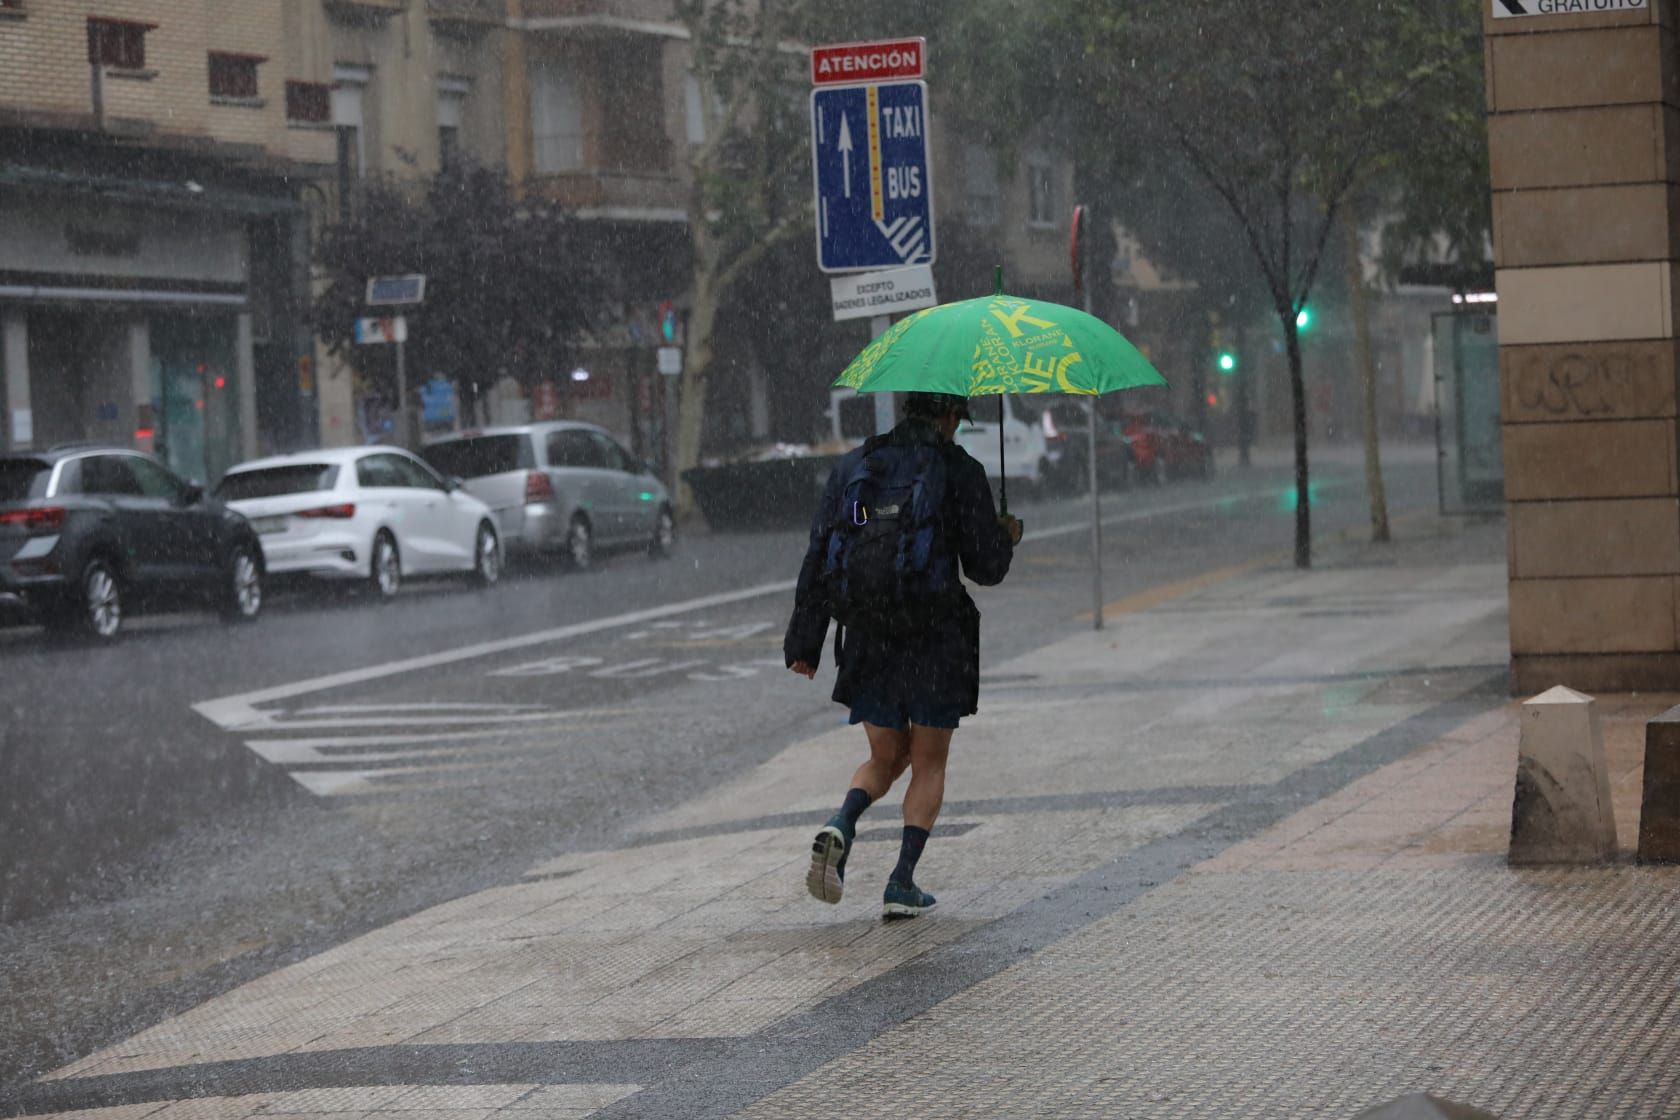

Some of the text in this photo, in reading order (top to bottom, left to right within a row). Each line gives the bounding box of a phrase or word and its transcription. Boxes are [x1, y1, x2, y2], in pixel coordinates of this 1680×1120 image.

[819, 49, 917, 73] ATENCIÓN
[882, 105, 921, 139] TAXI
[888, 166, 921, 199] BUS
[856, 280, 895, 295] EXCEPTO
[867, 287, 932, 306] LEGALIZADOS
